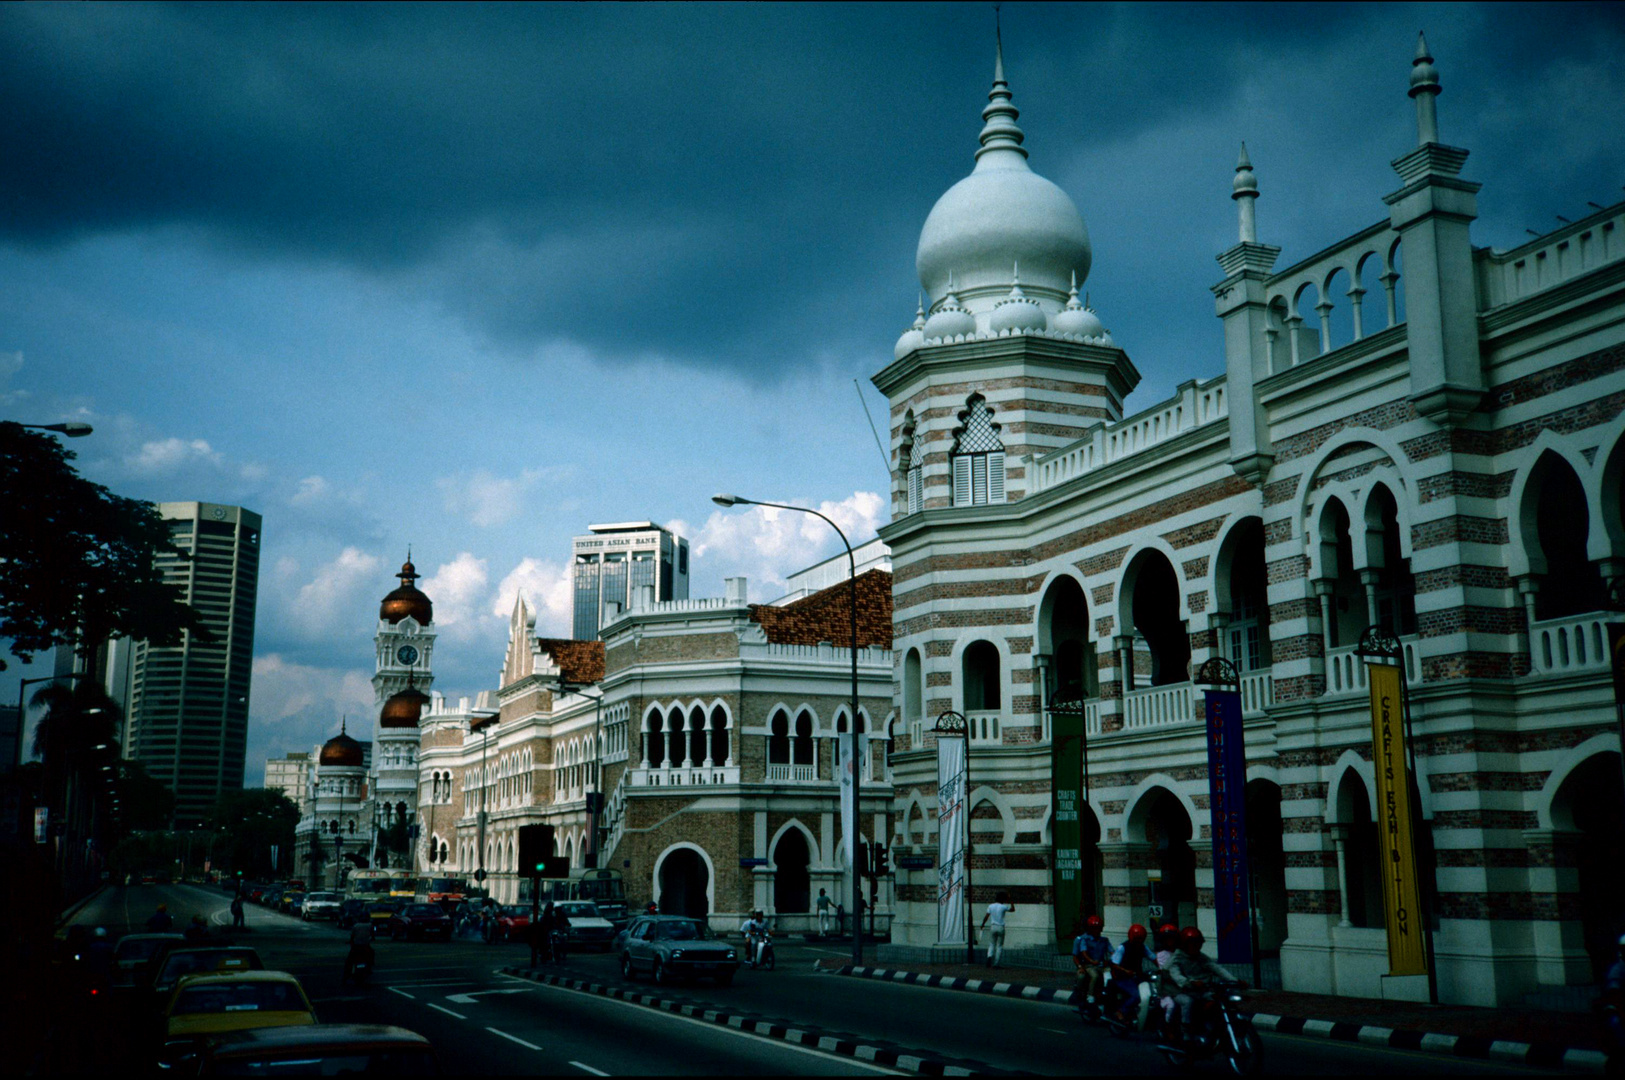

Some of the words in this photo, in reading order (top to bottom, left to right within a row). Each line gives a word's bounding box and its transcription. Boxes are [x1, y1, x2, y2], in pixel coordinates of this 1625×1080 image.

[576, 540, 603, 548] UNITED
[635, 537, 657, 545] BANK
[1381, 696, 1395, 780] CRAFTS
[1057, 789, 1076, 801] CRAFTS
[1056, 811, 1078, 821] COUNTER
[1057, 848, 1079, 859] KAUNTER
[1229, 811, 1242, 904] CRAFTS
[1386, 790, 1408, 937] EXHIBITION
